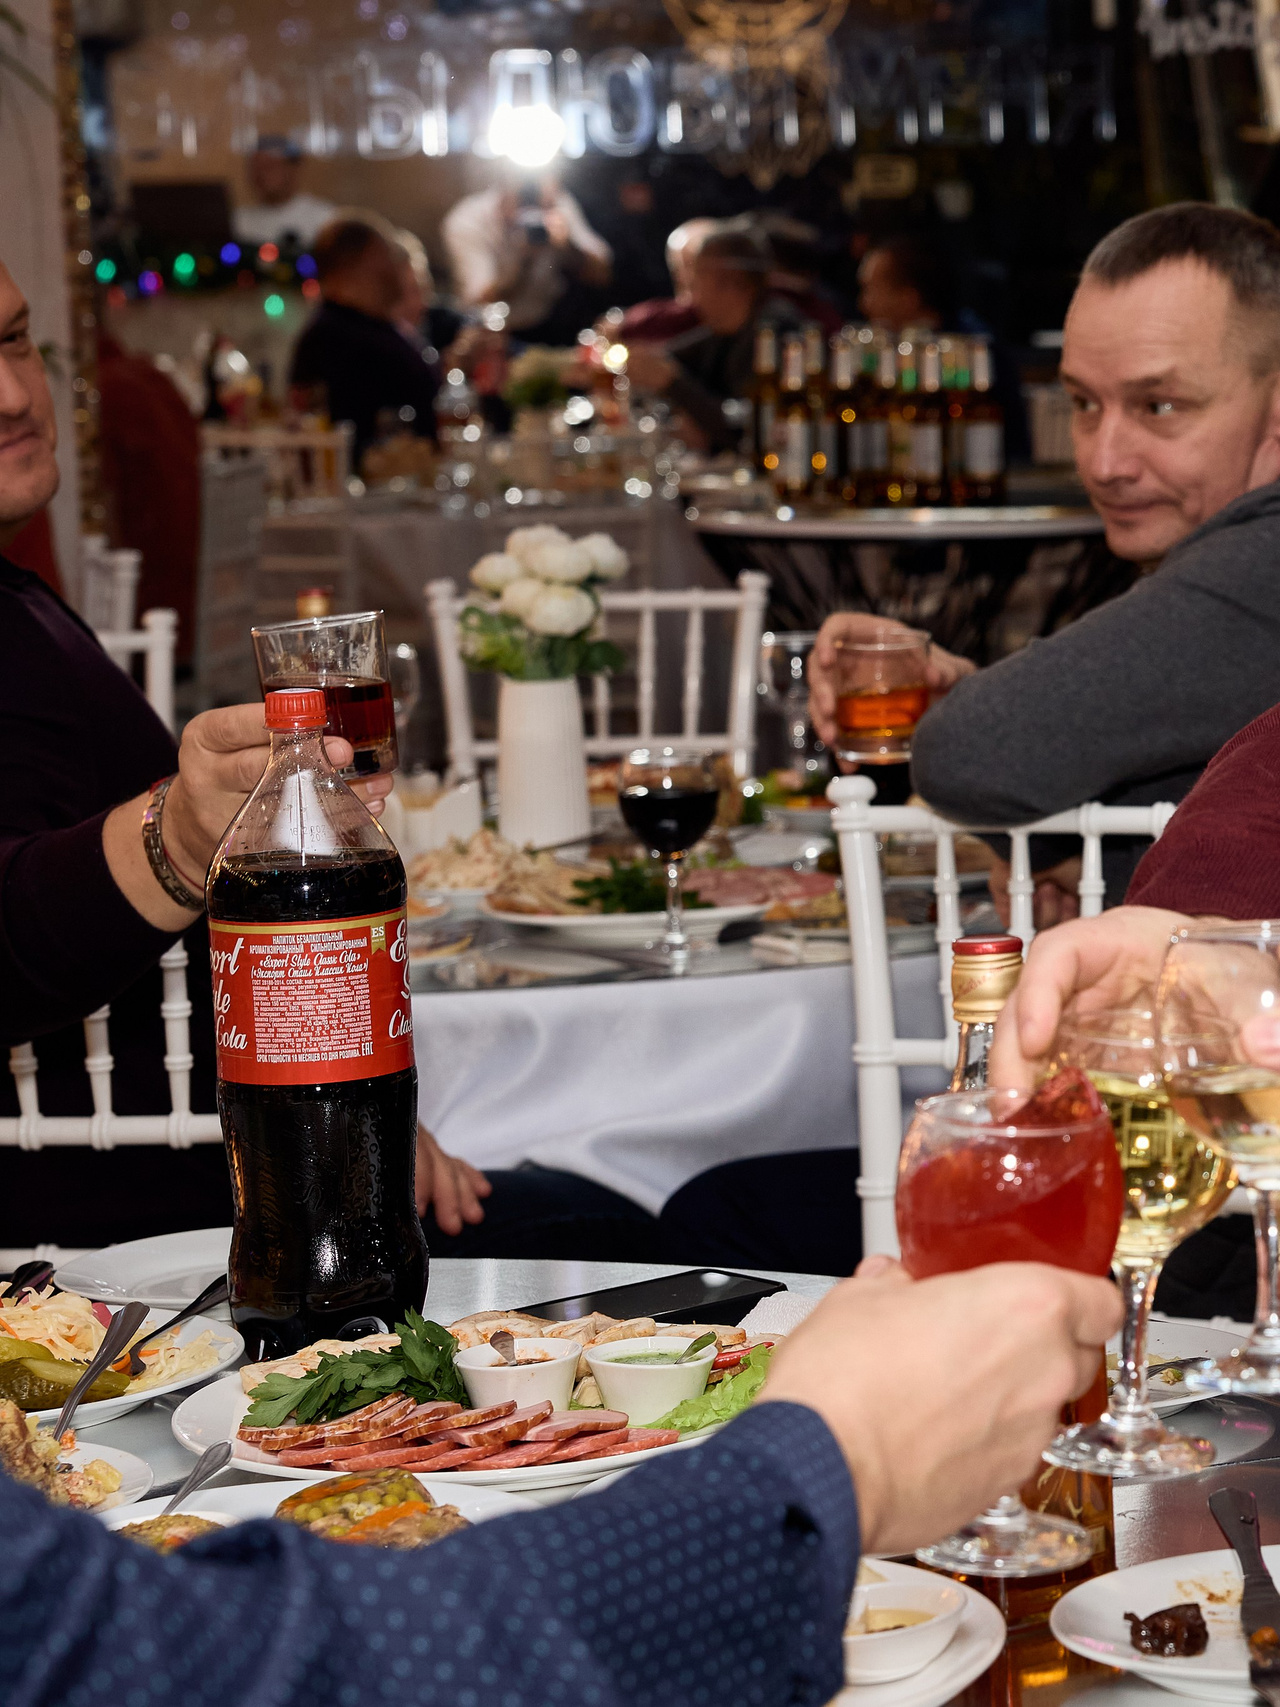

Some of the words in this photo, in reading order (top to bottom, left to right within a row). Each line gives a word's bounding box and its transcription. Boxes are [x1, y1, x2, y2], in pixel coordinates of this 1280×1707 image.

[272, 935, 296, 945] НАПИТОК
[296, 930, 343, 944] БЕЗАЛКОГОЛЬНЫЙ
[372, 926, 384, 938] ES
[249, 944, 304, 954] АРОМАТИЗИРОВАННЫЙ
[310, 937, 367, 953] СИЛЬНОГАЗИРОВАННЫЙ
[290, 953, 311, 969] Style
[313, 952, 338, 966] Classic
[315, 965, 345, 977] Классик
[216, 1015, 247, 1050] Cola
[256, 1054, 267, 1062] СРОК
[267, 1054, 291, 1062] ГОДНОСТИ
[297, 1052, 320, 1061] МЕСЯЦЕВ
[320, 1052, 327, 1060] СО
[328, 1051, 338, 1059] ДНЯ
